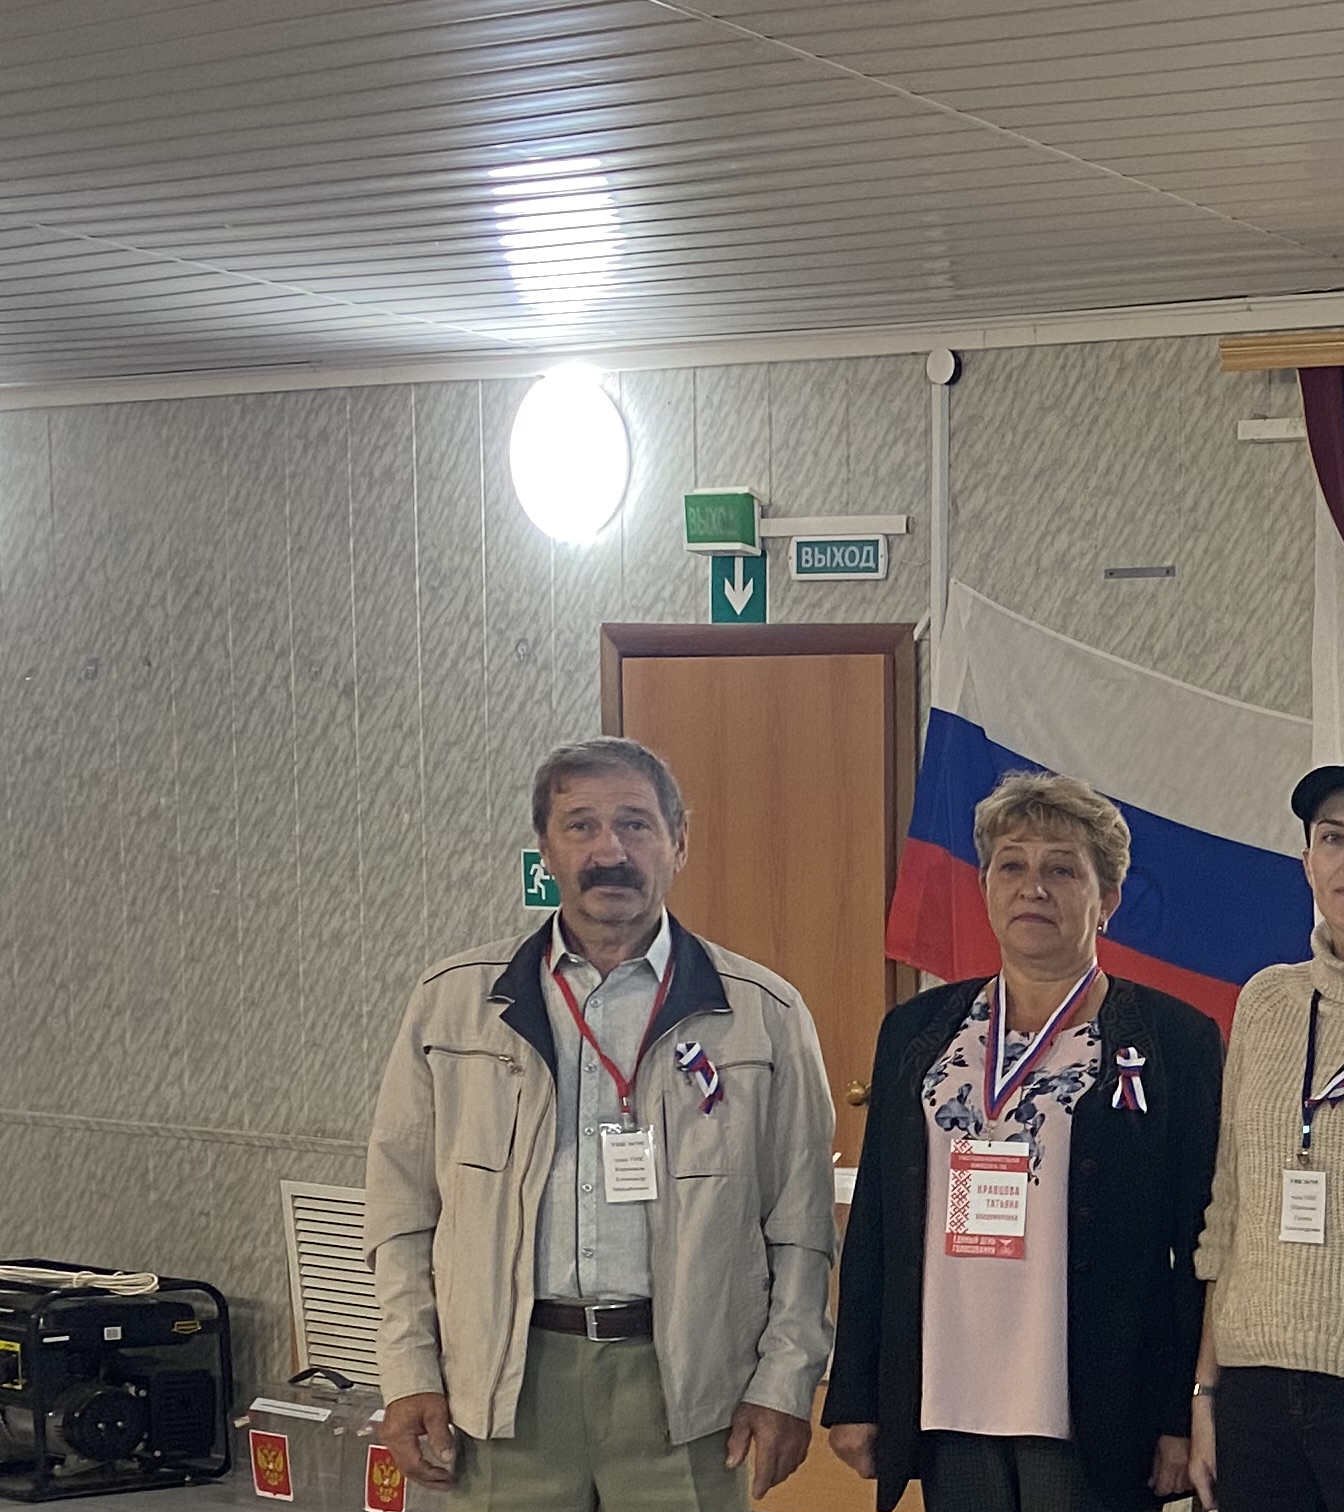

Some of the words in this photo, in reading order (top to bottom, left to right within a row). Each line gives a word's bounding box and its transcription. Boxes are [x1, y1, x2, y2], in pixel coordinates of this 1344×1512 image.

[801, 546, 876, 568] ВЫХОД
[977, 1184, 1020, 1196] КРАВЦОВА
[986, 1198, 1018, 1209] ТАТЬЯНА
